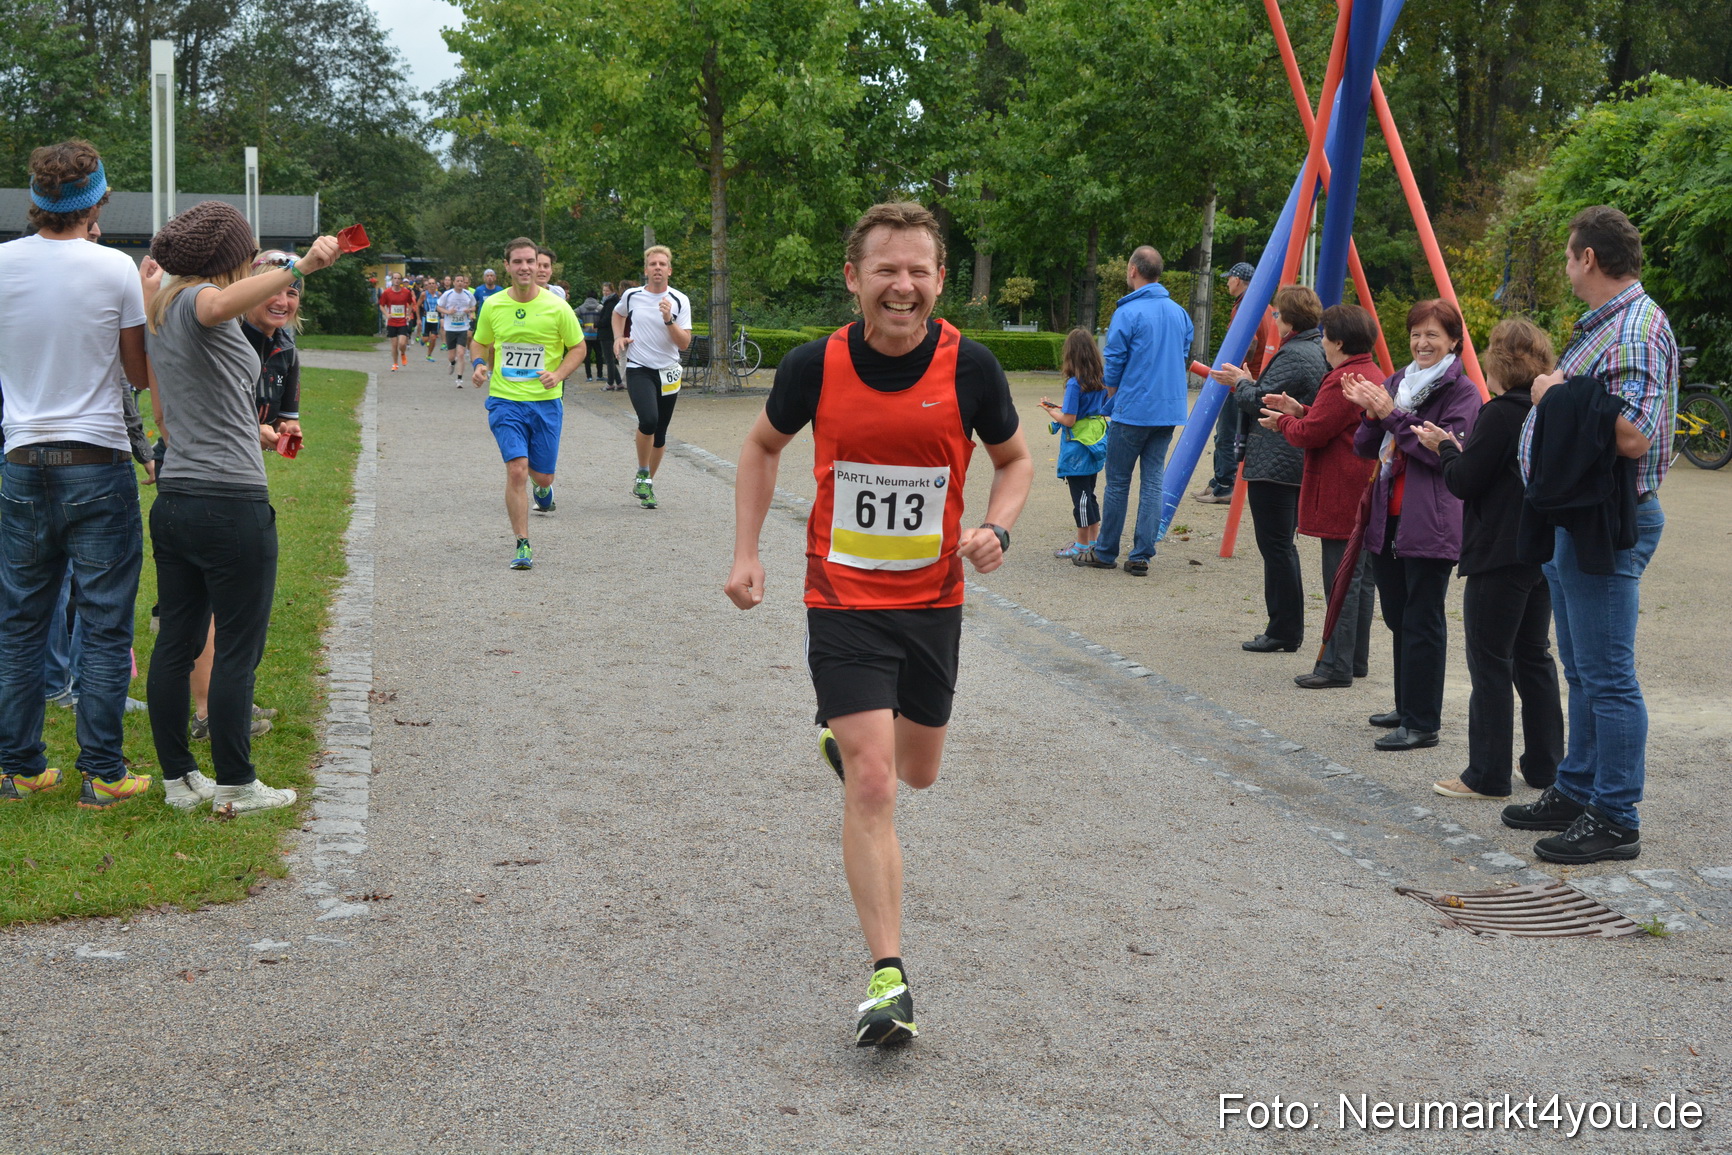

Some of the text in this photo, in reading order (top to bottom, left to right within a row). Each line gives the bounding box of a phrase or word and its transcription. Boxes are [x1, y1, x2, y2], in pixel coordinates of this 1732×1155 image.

[506, 352, 541, 368] 2777
[28, 450, 73, 464] PMA
[836, 470, 931, 488] PARTL Neumarkt
[856, 490, 925, 531] 613
